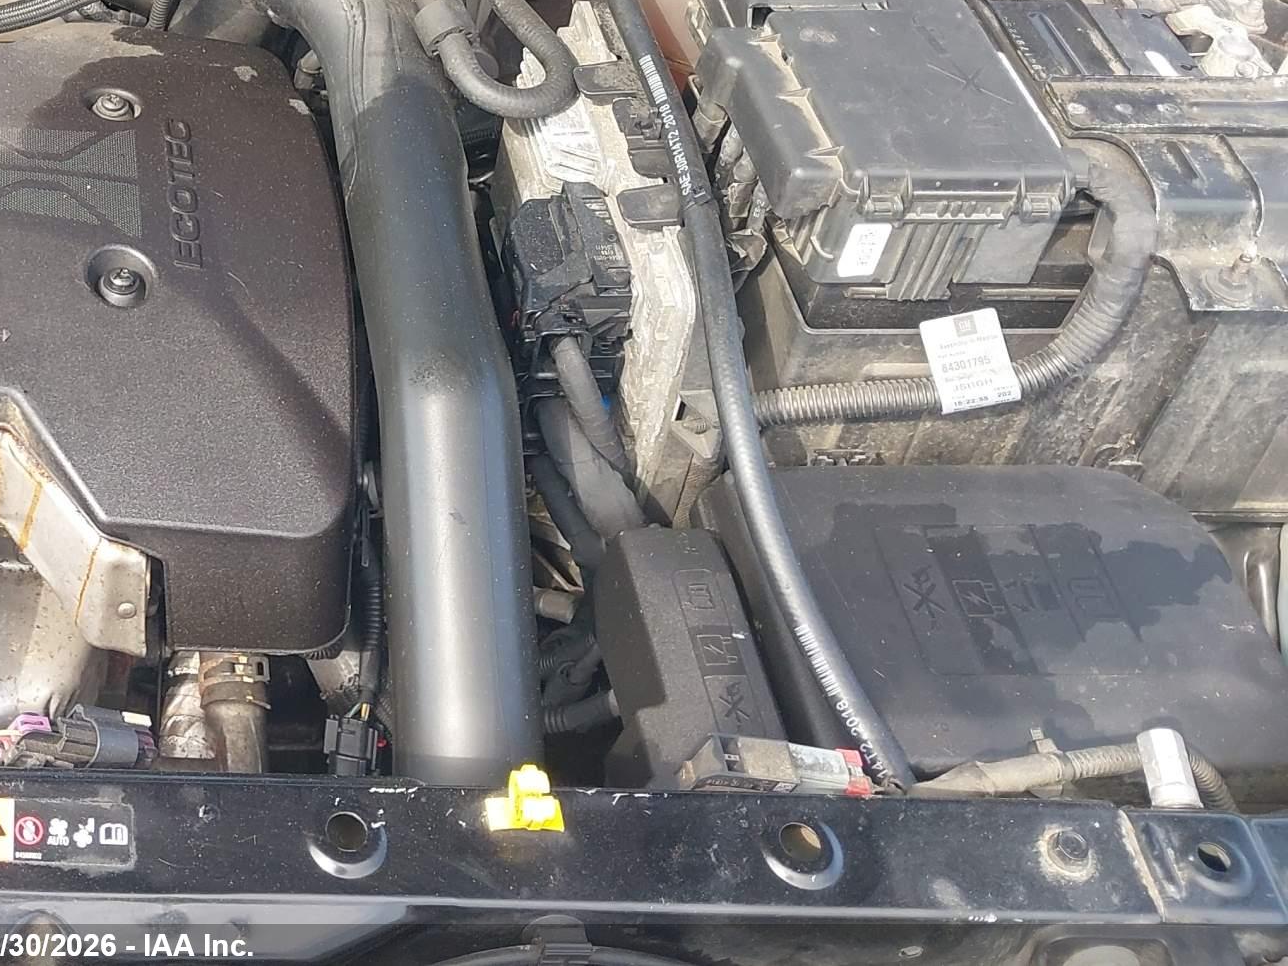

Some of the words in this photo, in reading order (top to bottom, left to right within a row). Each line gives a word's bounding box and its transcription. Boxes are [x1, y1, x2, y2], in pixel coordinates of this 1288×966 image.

[659, 103, 676, 129] 2018
[164, 117, 203, 269] ECOTEC
[679, 171, 692, 196] SAE
[836, 699, 864, 737] 2018
[47, 835, 70, 846] AUTO
